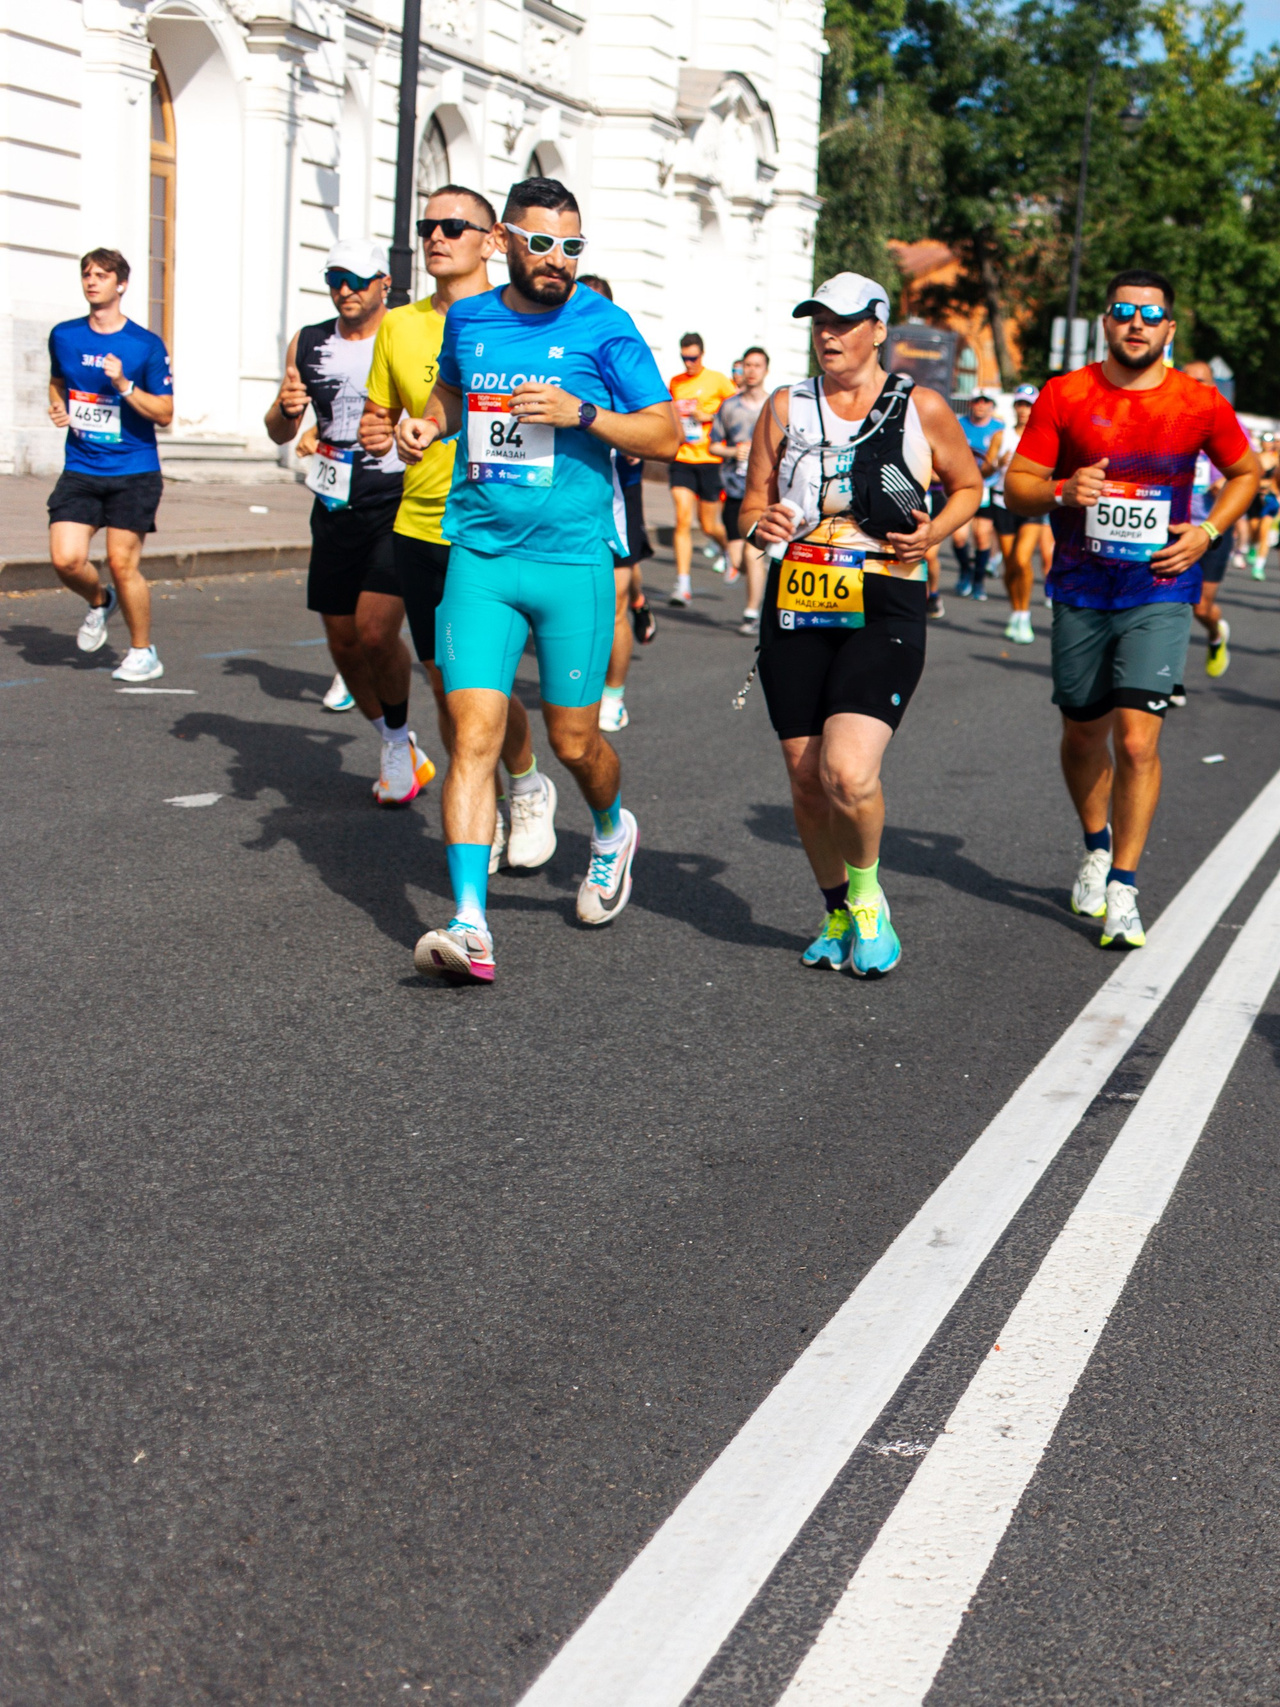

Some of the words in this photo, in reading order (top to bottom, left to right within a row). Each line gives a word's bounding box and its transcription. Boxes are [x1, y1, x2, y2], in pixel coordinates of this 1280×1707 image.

[75, 405, 113, 424] 4657
[490, 420, 523, 448] 84
[485, 449, 526, 459] РАМАЗАН
[317, 460, 337, 485] 713
[1096, 503, 1157, 529] 5056
[1110, 529, 1142, 539] АНДРЕЙ
[787, 569, 849, 600] 6016
[795, 598, 838, 609] НАДЕЖДА
[446, 622, 456, 661] DDLONG
